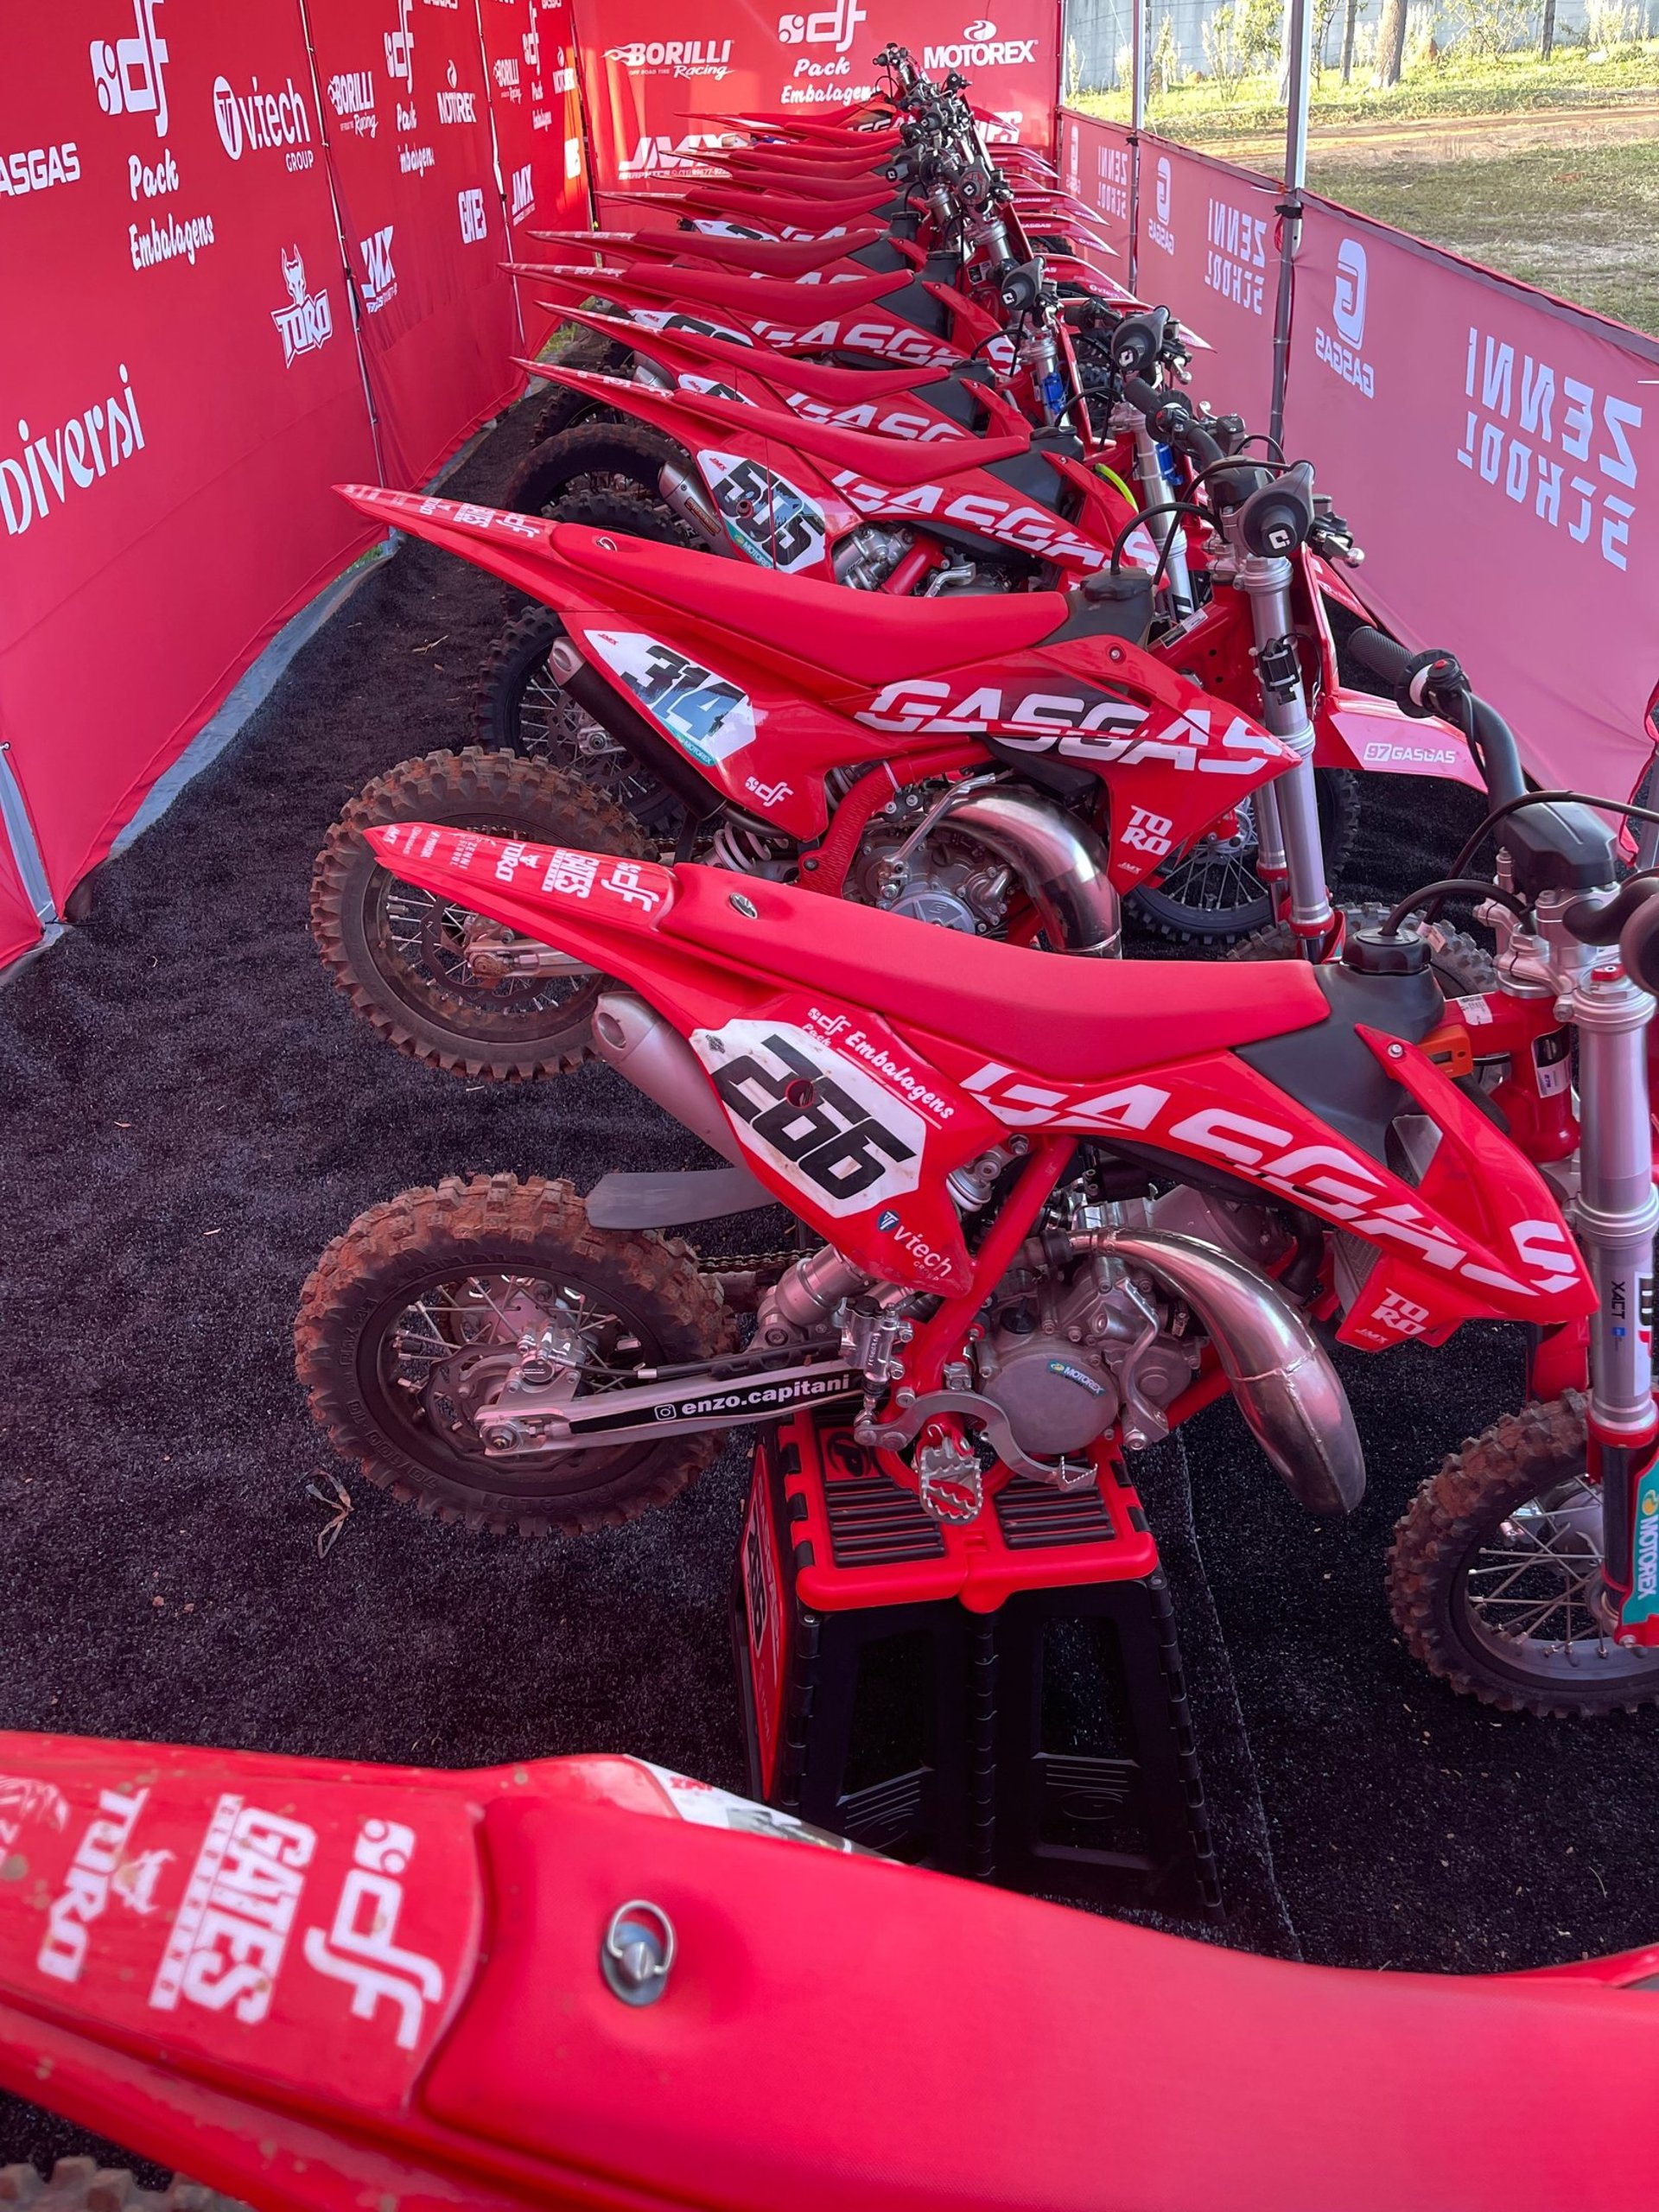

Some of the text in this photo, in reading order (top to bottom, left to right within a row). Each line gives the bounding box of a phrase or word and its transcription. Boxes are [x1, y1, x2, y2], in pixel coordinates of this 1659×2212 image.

[615, 40, 734, 67] BORILLI
[673, 64, 734, 81] Racing
[793, 56, 850, 78] Pack
[923, 40, 1038, 69] MOTOREX
[0, 142, 80, 198] ASGAS
[128, 148, 179, 201] Pack
[285, 149, 314, 173] GROUP
[128, 213, 214, 270] Embalagens
[270, 289, 333, 368] TORO
[0, 363, 145, 535] Diversi
[620, 645, 747, 741] 314
[855, 679, 1282, 774] GASGAS
[844, 1031, 955, 1121] Embalagens
[710, 1033, 918, 1200] 266
[959, 1061, 1580, 1296] GASGAS
[681, 1374, 849, 1415] enzo.capitani
[1064, 1366, 1105, 1395] MOTOREX
[1637, 1515, 1659, 1600] MOTOREX
[36, 1788, 150, 1983] TORO
[181, 1805, 318, 2024] GATES
